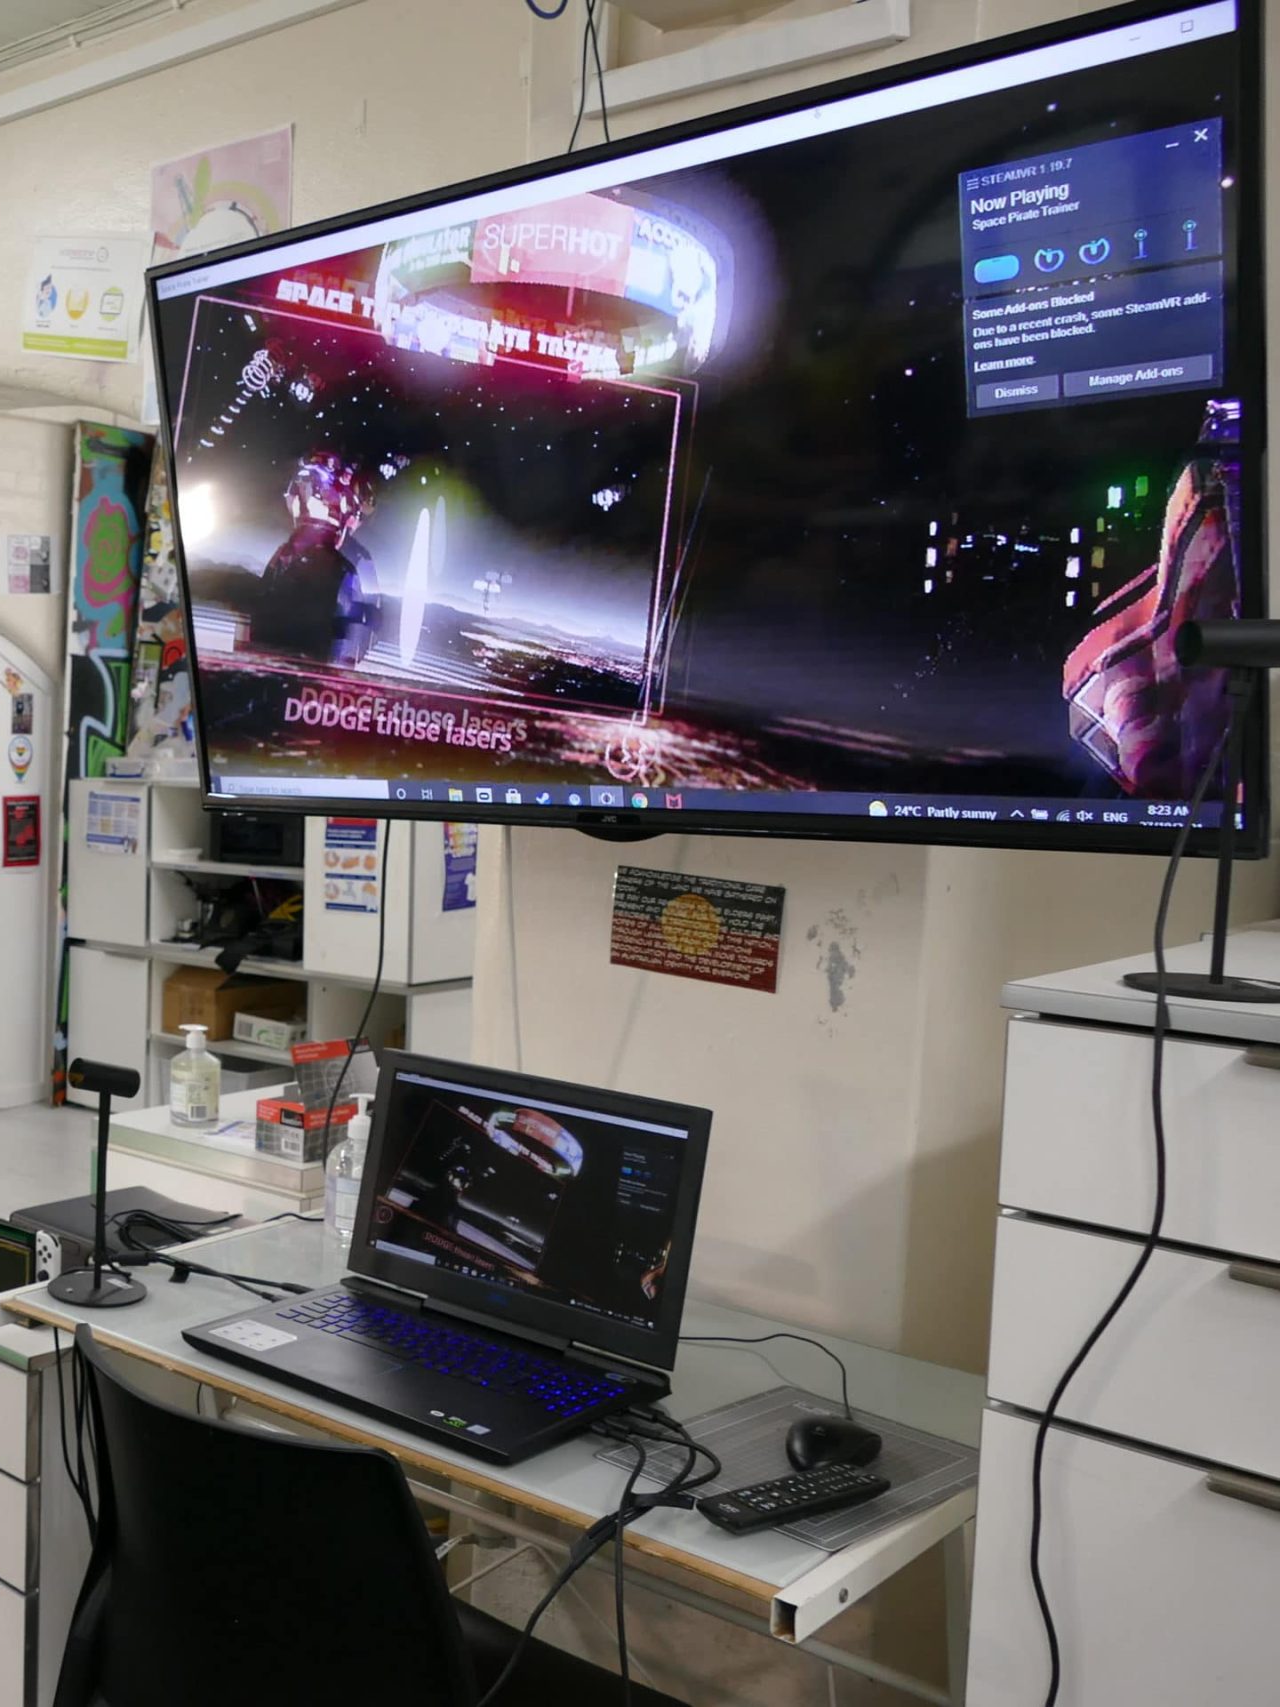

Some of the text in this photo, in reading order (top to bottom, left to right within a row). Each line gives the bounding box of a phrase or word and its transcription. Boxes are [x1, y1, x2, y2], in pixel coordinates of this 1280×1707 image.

[970, 183, 1070, 214] Now Playing
[972, 201, 1080, 231] Space Pirate Trainer
[483, 222, 623, 262] SUPERHOT
[275, 279, 354, 314] SPACE
[972, 291, 1094, 320] Some Add-ons Blocked
[973, 292, 1211, 337] Due to a recent crash, some SteamVR add-
[973, 323, 1096, 350] ons have been blocked.
[974, 360, 1004, 373] Learn
[1088, 366, 1184, 387] Manage Add-ons
[995, 385, 1039, 399] Dismiss
[284, 697, 512, 751] DODGE those lasers
[894, 805, 997, 820] 24°C Partly sunny
[1103, 812, 1129, 823] ENG
[1147, 805, 1171, 816] 8:23
